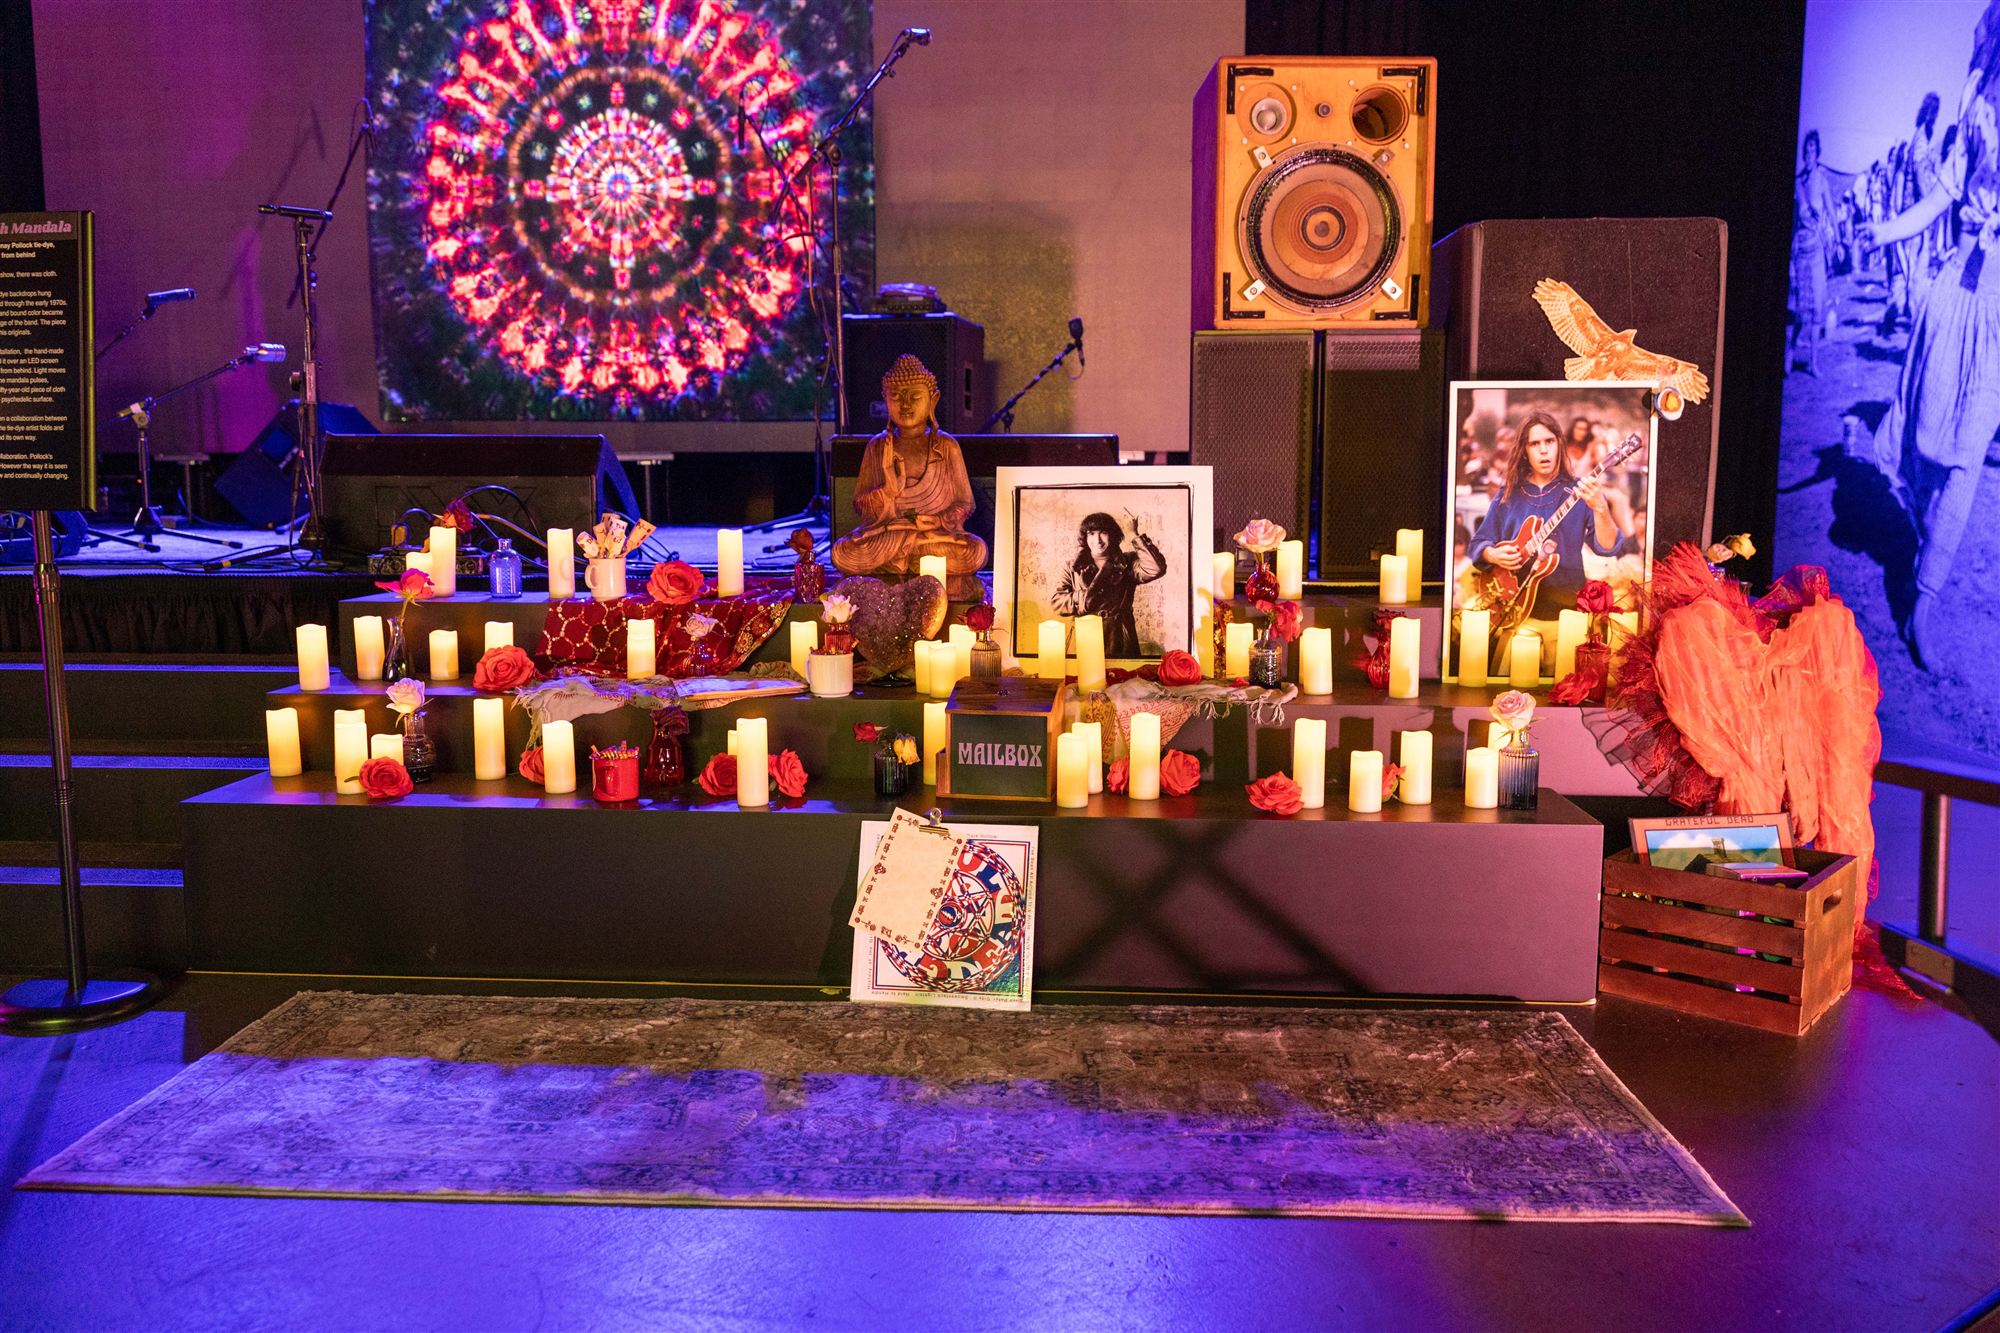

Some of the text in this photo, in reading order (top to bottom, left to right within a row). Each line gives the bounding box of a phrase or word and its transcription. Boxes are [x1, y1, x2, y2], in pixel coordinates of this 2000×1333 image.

[12, 220, 72, 234] Mandala
[958, 742, 1043, 767] MAILBOX
[1665, 815, 1755, 827] GRATEFUL DEAD
